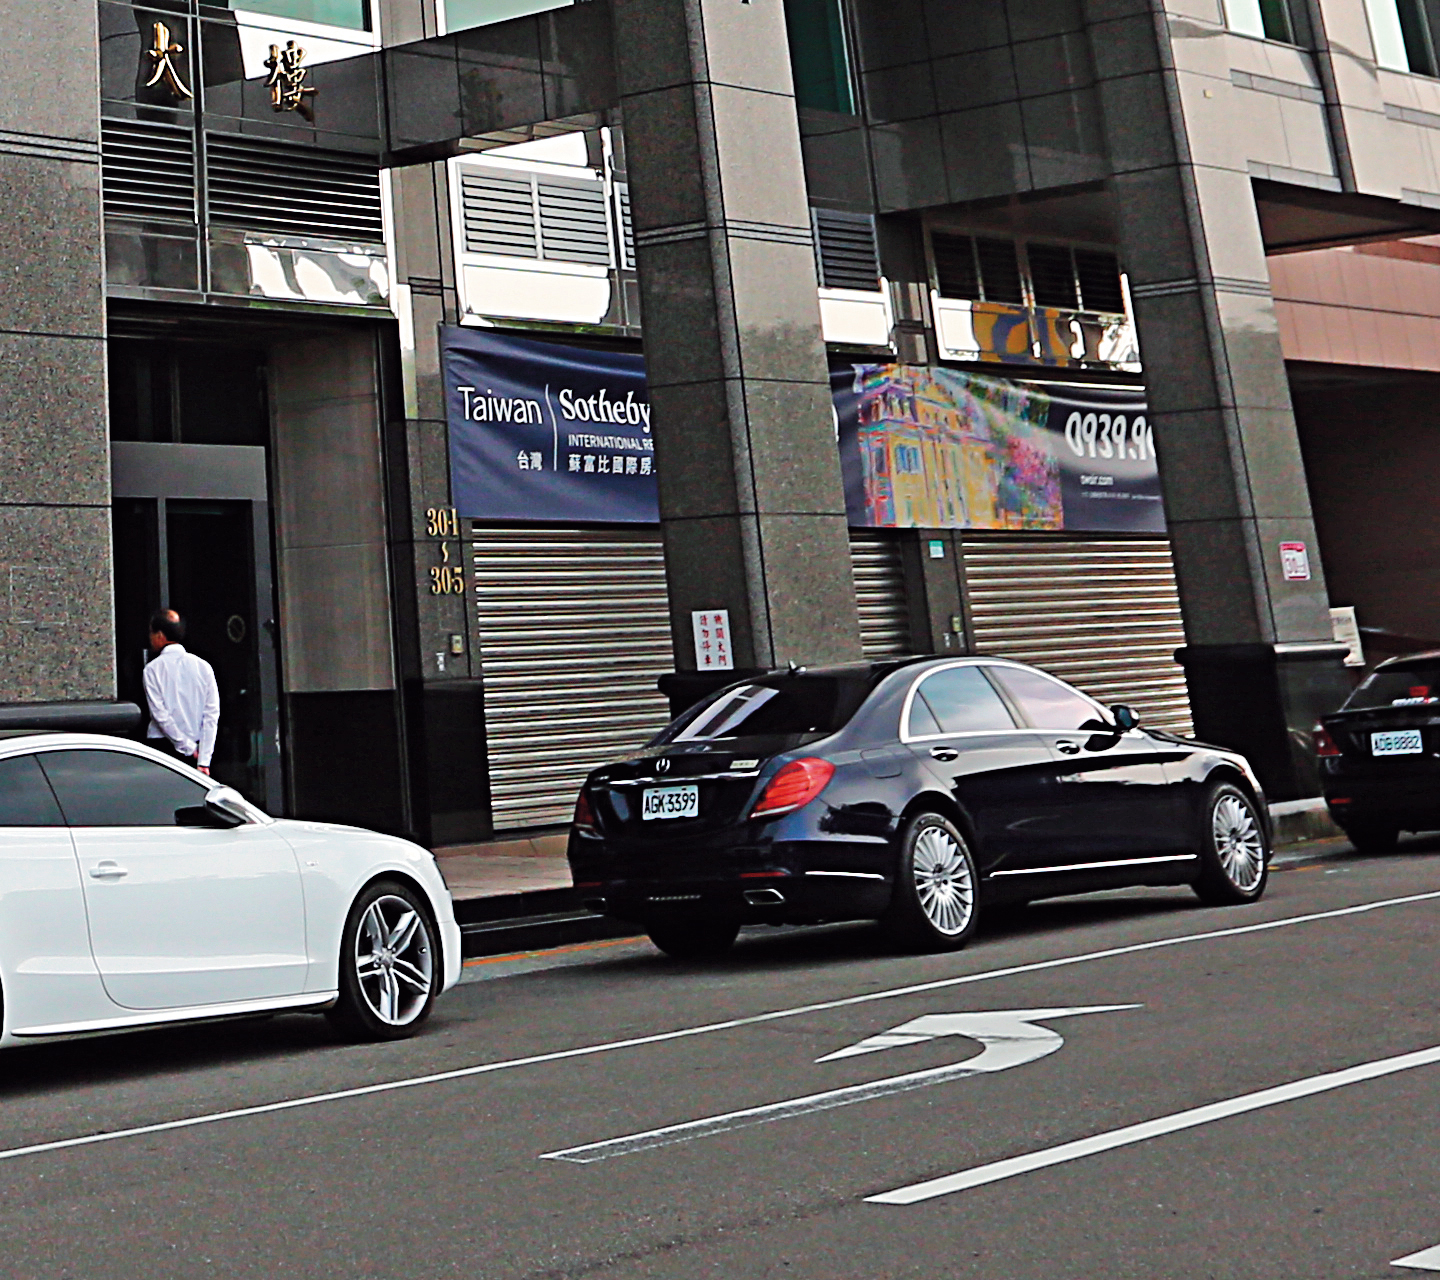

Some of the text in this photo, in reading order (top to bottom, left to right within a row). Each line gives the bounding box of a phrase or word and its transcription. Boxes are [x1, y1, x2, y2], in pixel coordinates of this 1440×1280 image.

[457, 386, 543, 426] Taiwan
[568, 434, 642, 450] INTERNATIONAL
[517, 450, 543, 472] 台灣
[568, 453, 658, 476] 蘇富比國際房
[644, 792, 696, 814] AGK-3399
